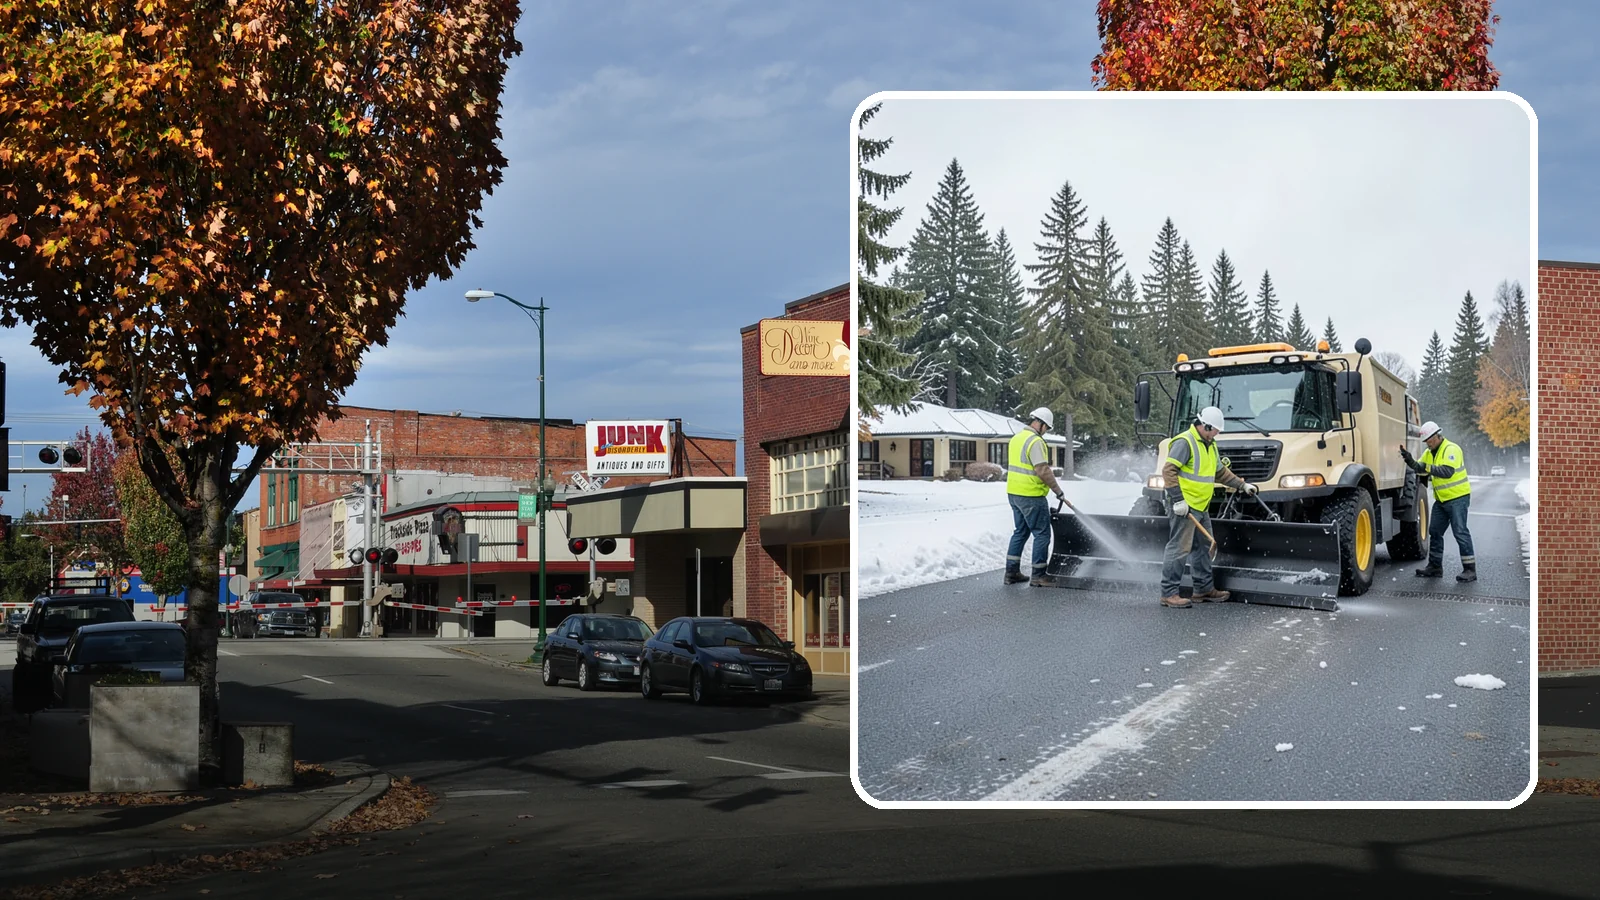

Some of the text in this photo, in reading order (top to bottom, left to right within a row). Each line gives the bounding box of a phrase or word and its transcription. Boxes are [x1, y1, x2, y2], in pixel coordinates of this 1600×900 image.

[595, 425, 665, 457] JUNK
[607, 445, 646, 454] DISORDERLY
[596, 460, 665, 470] ANTIQUES AND GIFTS
[390, 519, 429, 540] Trackside Pizza
